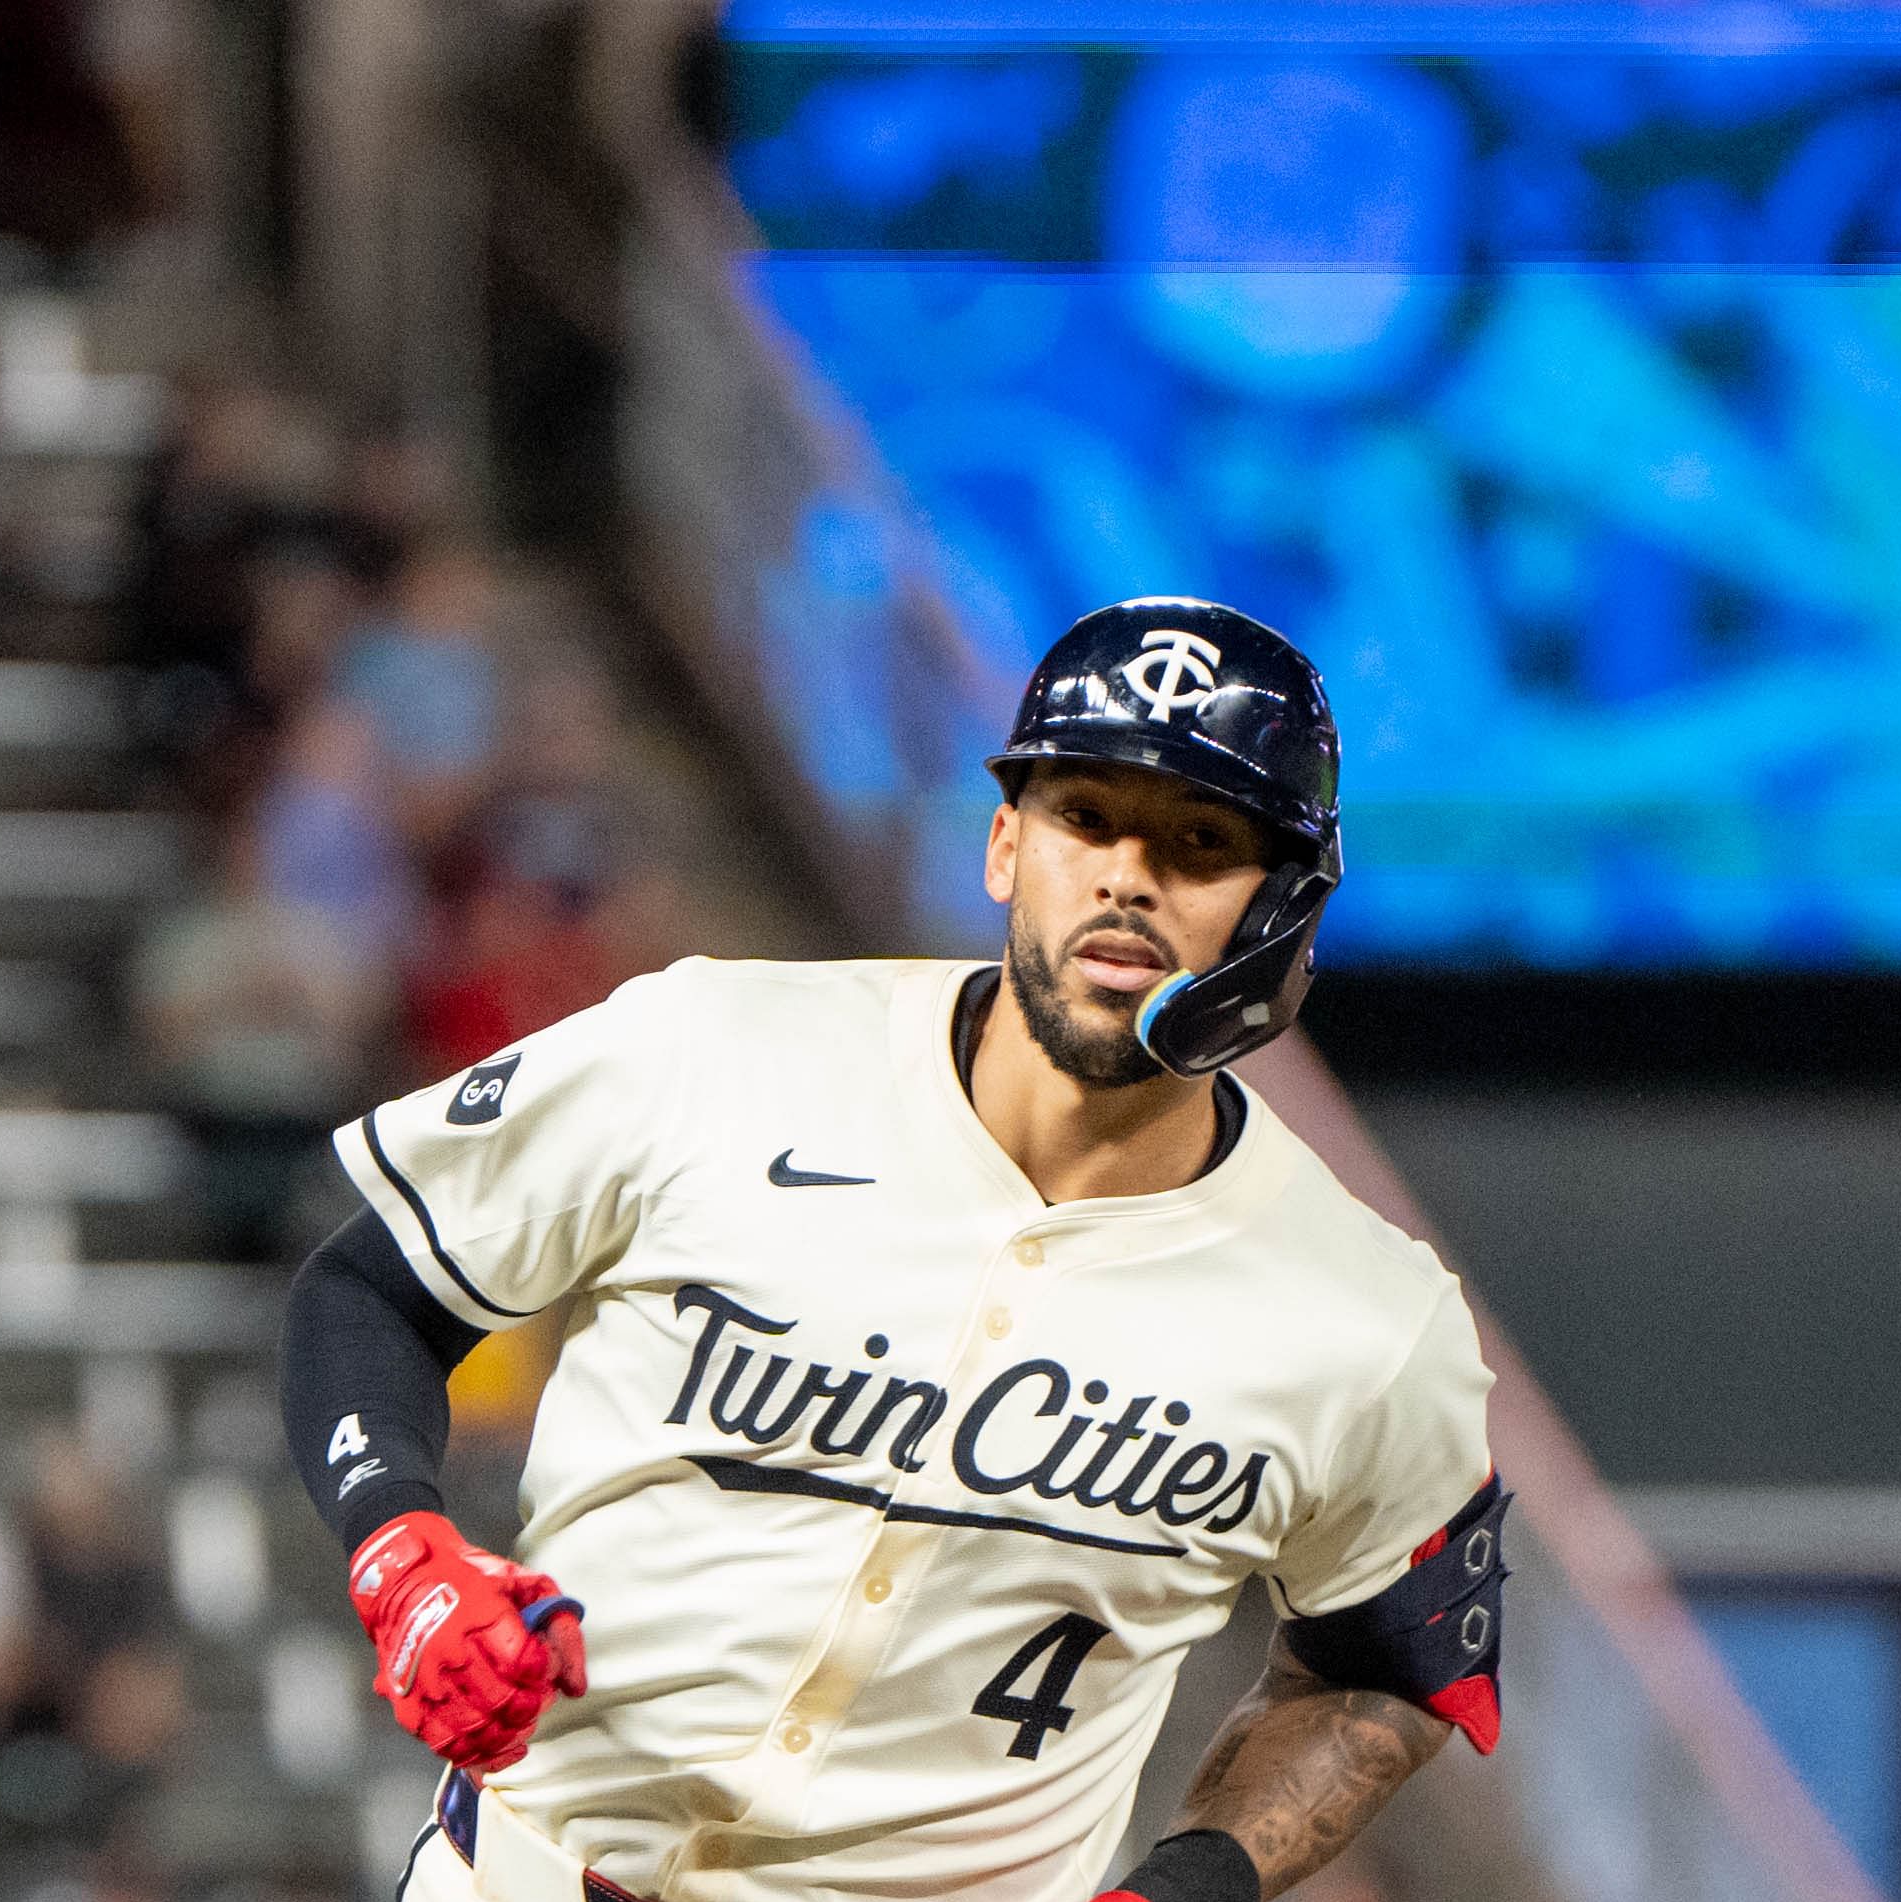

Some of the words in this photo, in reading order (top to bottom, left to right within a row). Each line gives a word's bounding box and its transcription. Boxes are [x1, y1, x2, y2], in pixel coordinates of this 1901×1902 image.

[327, 1411, 369, 1466] 4
[663, 1283, 949, 1473] Twin
[951, 1358, 1272, 1534] Cities
[970, 1611, 1112, 1761] 4
